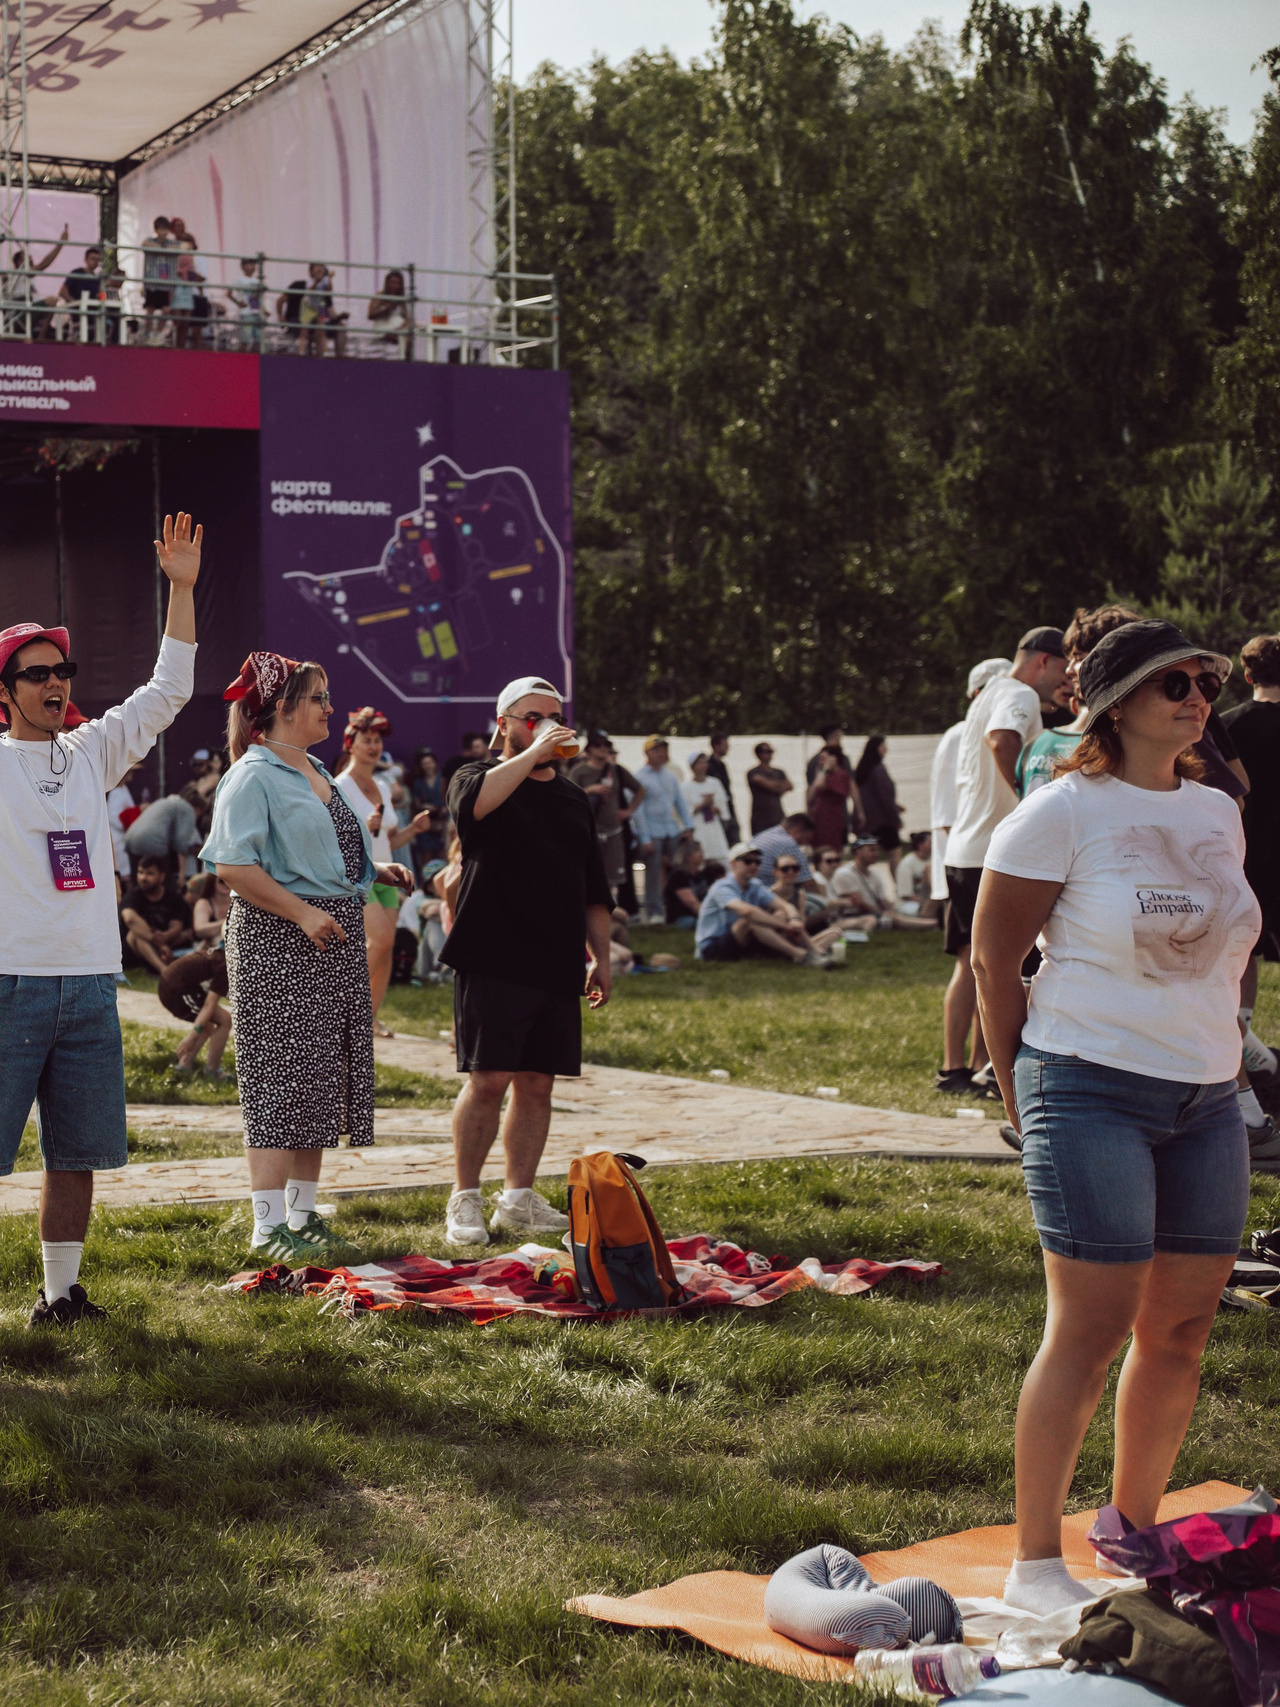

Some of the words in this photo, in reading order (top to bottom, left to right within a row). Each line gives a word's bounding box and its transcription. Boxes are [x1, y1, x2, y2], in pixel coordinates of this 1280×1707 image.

[271, 480, 332, 497] карта
[271, 496, 392, 517] фестиваля:
[1136, 890, 1192, 902] Choose
[1140, 901, 1205, 916] Empathy
